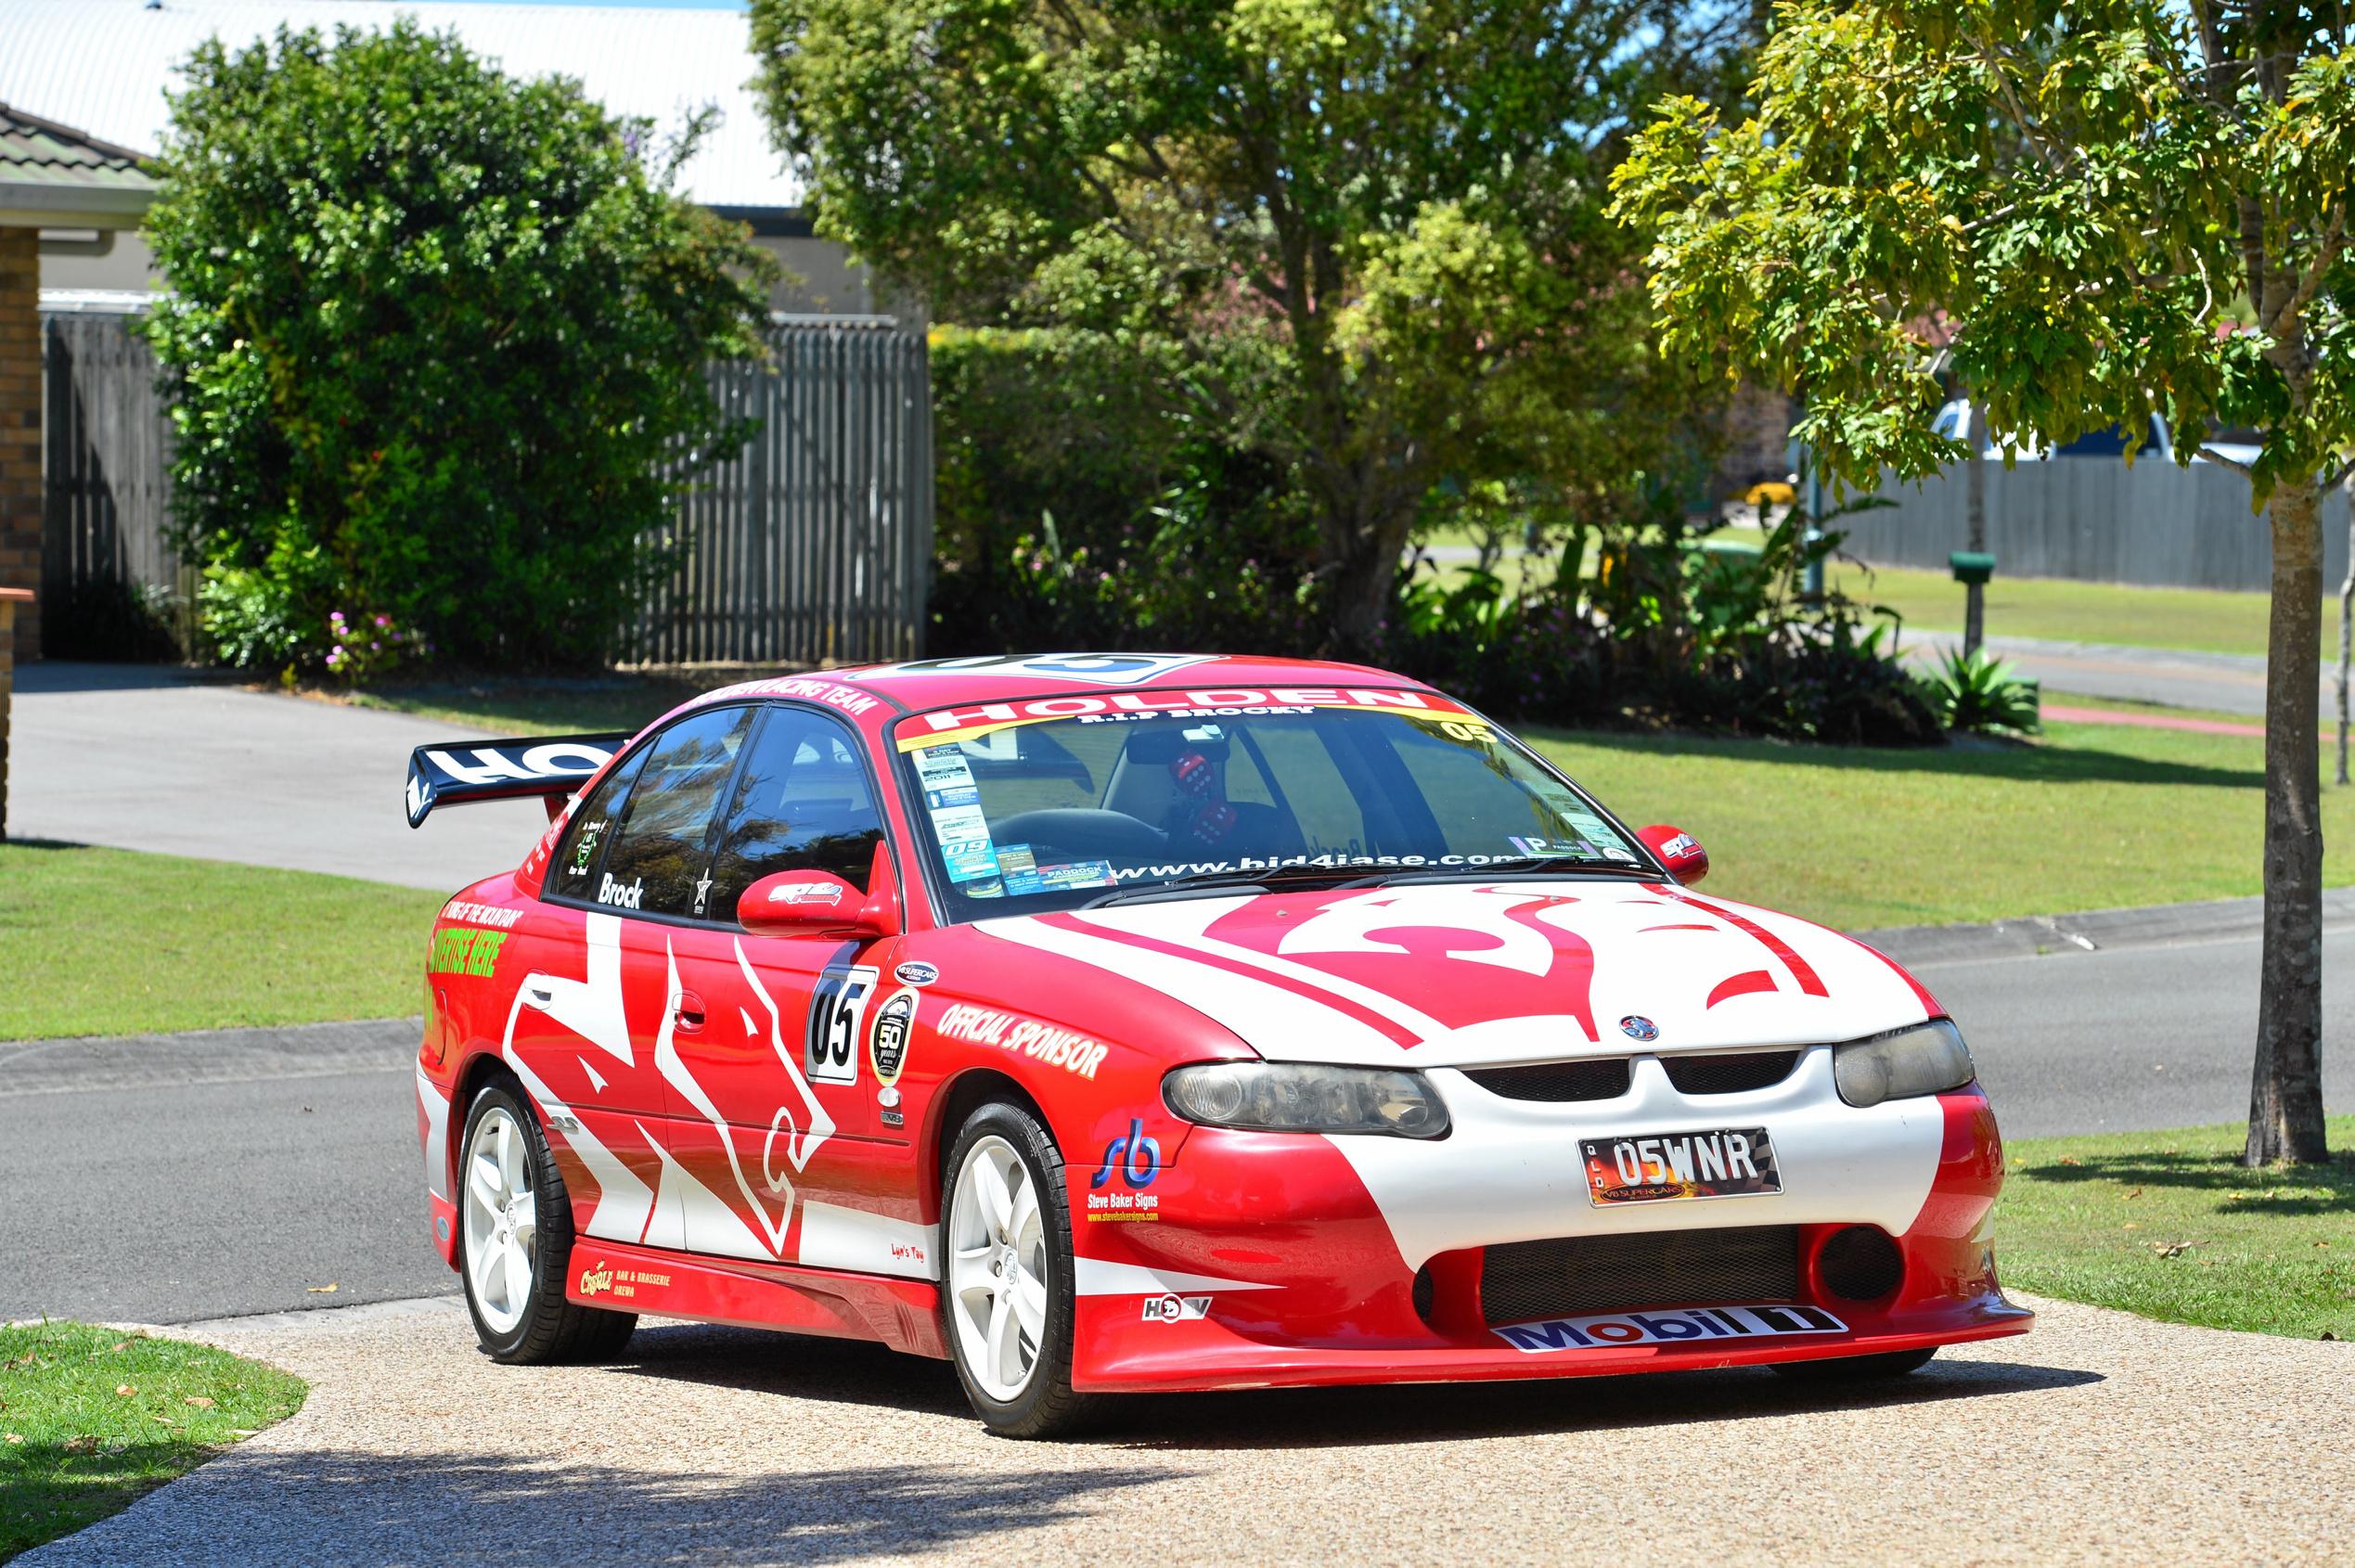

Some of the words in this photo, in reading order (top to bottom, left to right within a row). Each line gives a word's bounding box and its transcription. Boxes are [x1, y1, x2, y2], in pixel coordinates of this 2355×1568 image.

[820, 688, 878, 716] TEAM
[924, 689, 1428, 730] HOLDEN
[1078, 711, 1158, 724] R.I.P
[1167, 706, 1315, 718] BROCKY
[1440, 721, 1499, 743] 05
[945, 840, 988, 856] 09
[1048, 866, 1102, 878] PADDOCK
[598, 872, 644, 909] Brock
[466, 929, 508, 978] HERE
[812, 979, 867, 1067] 05
[879, 1024, 902, 1049] 50
[936, 1003, 1014, 1046] OFFICIAL
[1000, 1021, 1109, 1082] SPONSOR
[1614, 1134, 1757, 1187] 05WNR
[1087, 1193, 1108, 1209] Steve
[1111, 1192, 1133, 1208] Baker
[1135, 1192, 1158, 1211] Signs
[1620, 1187, 1681, 1196] SUPERCARS
[1087, 1212, 1159, 1223] www.stevebakersigns.com
[910, 1246, 924, 1264] Toy
[616, 1270, 629, 1281] BAR
[630, 1271, 636, 1282] &
[637, 1272, 671, 1287] BRASSERIE
[1495, 1309, 1752, 1350] Mobil
[1768, 1307, 1817, 1330] 1
